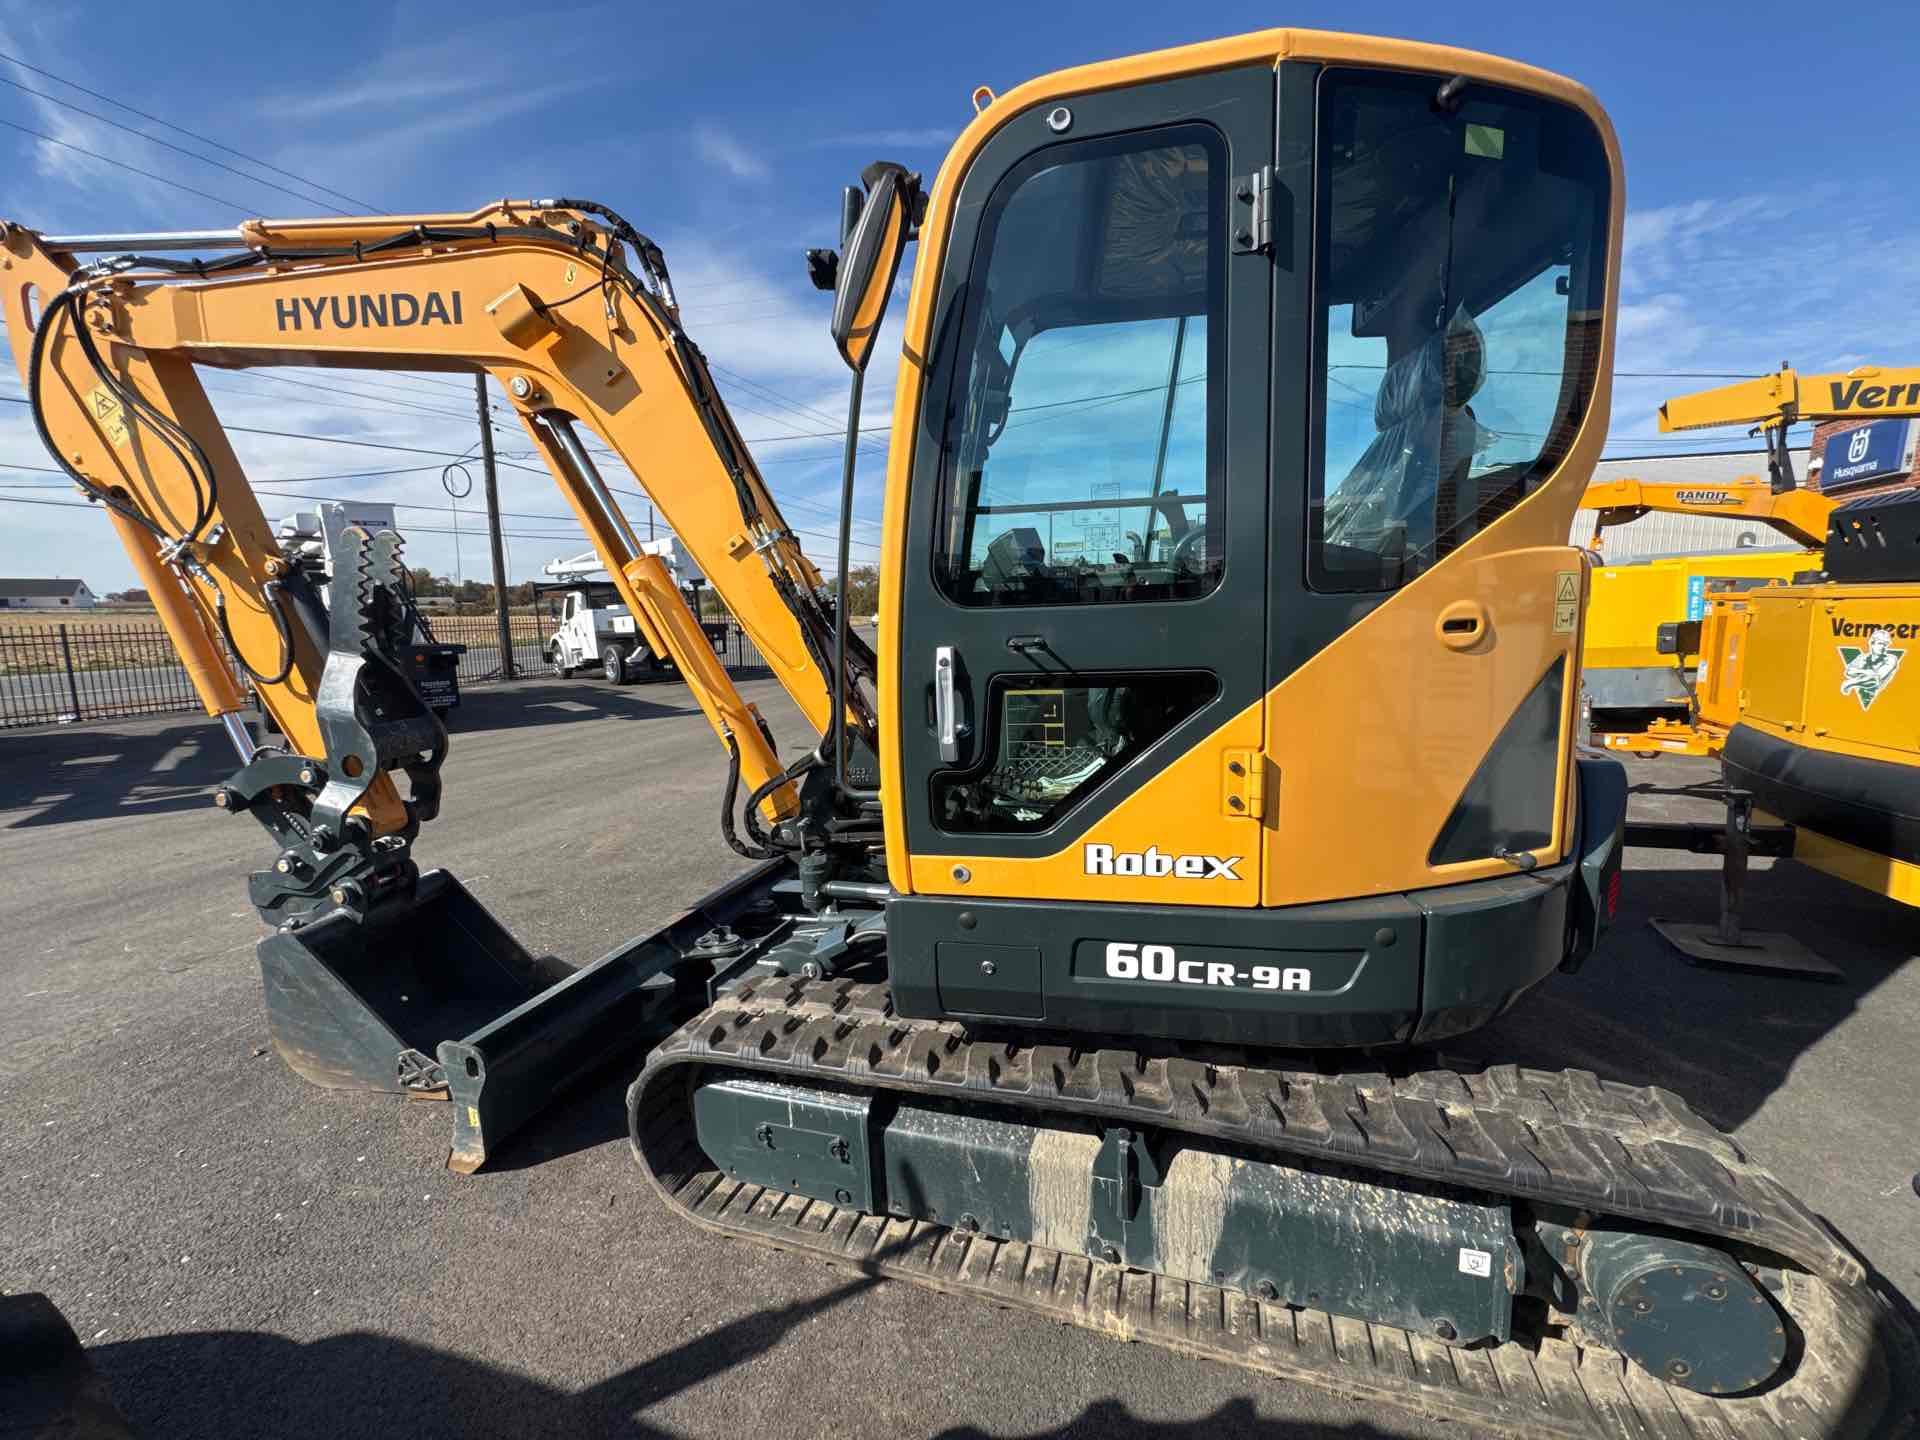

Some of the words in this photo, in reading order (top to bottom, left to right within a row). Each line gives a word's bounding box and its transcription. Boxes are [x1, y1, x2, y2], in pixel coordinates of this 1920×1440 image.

[275, 291, 464, 331] HYUNDAI
[1833, 459, 1879, 479] Husqvarna
[1675, 490, 1729, 500] BANDIT
[1084, 842, 1244, 881] Robex
[1105, 942, 1312, 992] 60CR-9A
